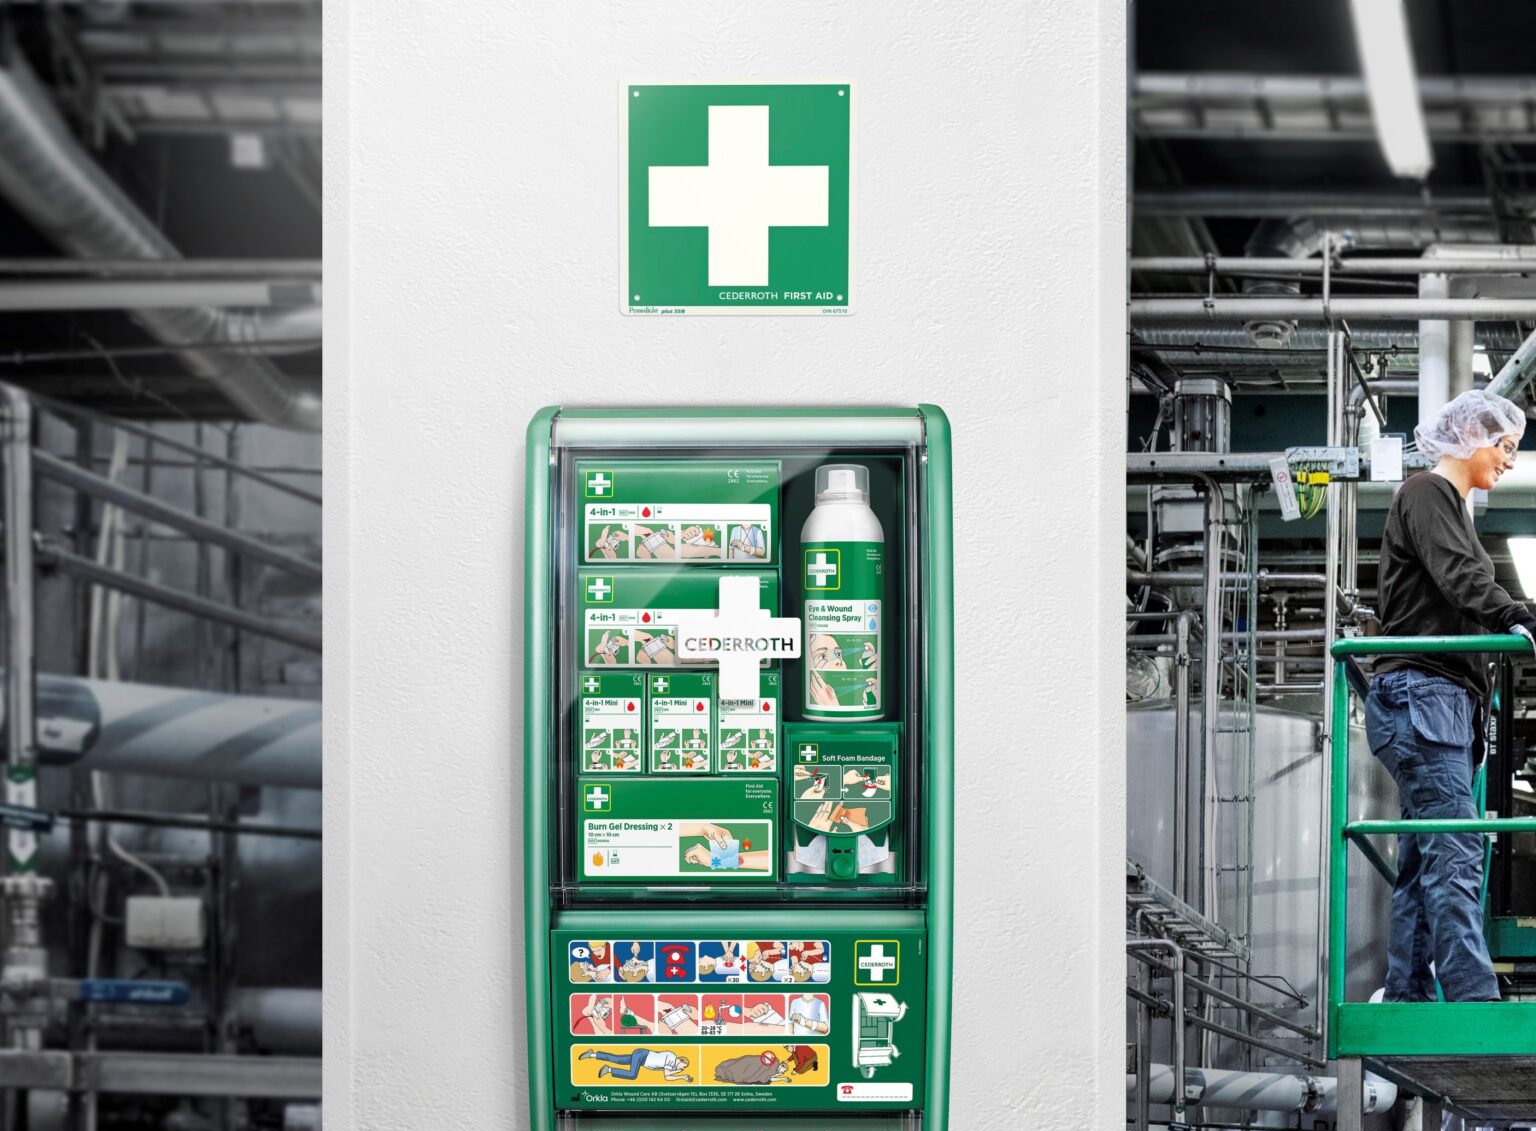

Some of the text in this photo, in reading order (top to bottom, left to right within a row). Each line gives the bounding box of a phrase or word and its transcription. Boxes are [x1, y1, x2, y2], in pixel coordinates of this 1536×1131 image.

[718, 291, 834, 300] CEDERROTH FIRST AID
[590, 508, 616, 516] 4-in-1
[808, 605, 820, 613] Eye
[590, 613, 616, 621] 4-in-1
[808, 614, 862, 623] Cleansing Spray
[684, 637, 794, 652] CEDERROTH
[856, 755, 886, 763] Bandage
[588, 822, 607, 831] Burn
[608, 822, 622, 831] Gel
[624, 822, 658, 832] Dressing
[667, 822, 673, 831] 2
[586, 1094, 608, 1102] Orkla
